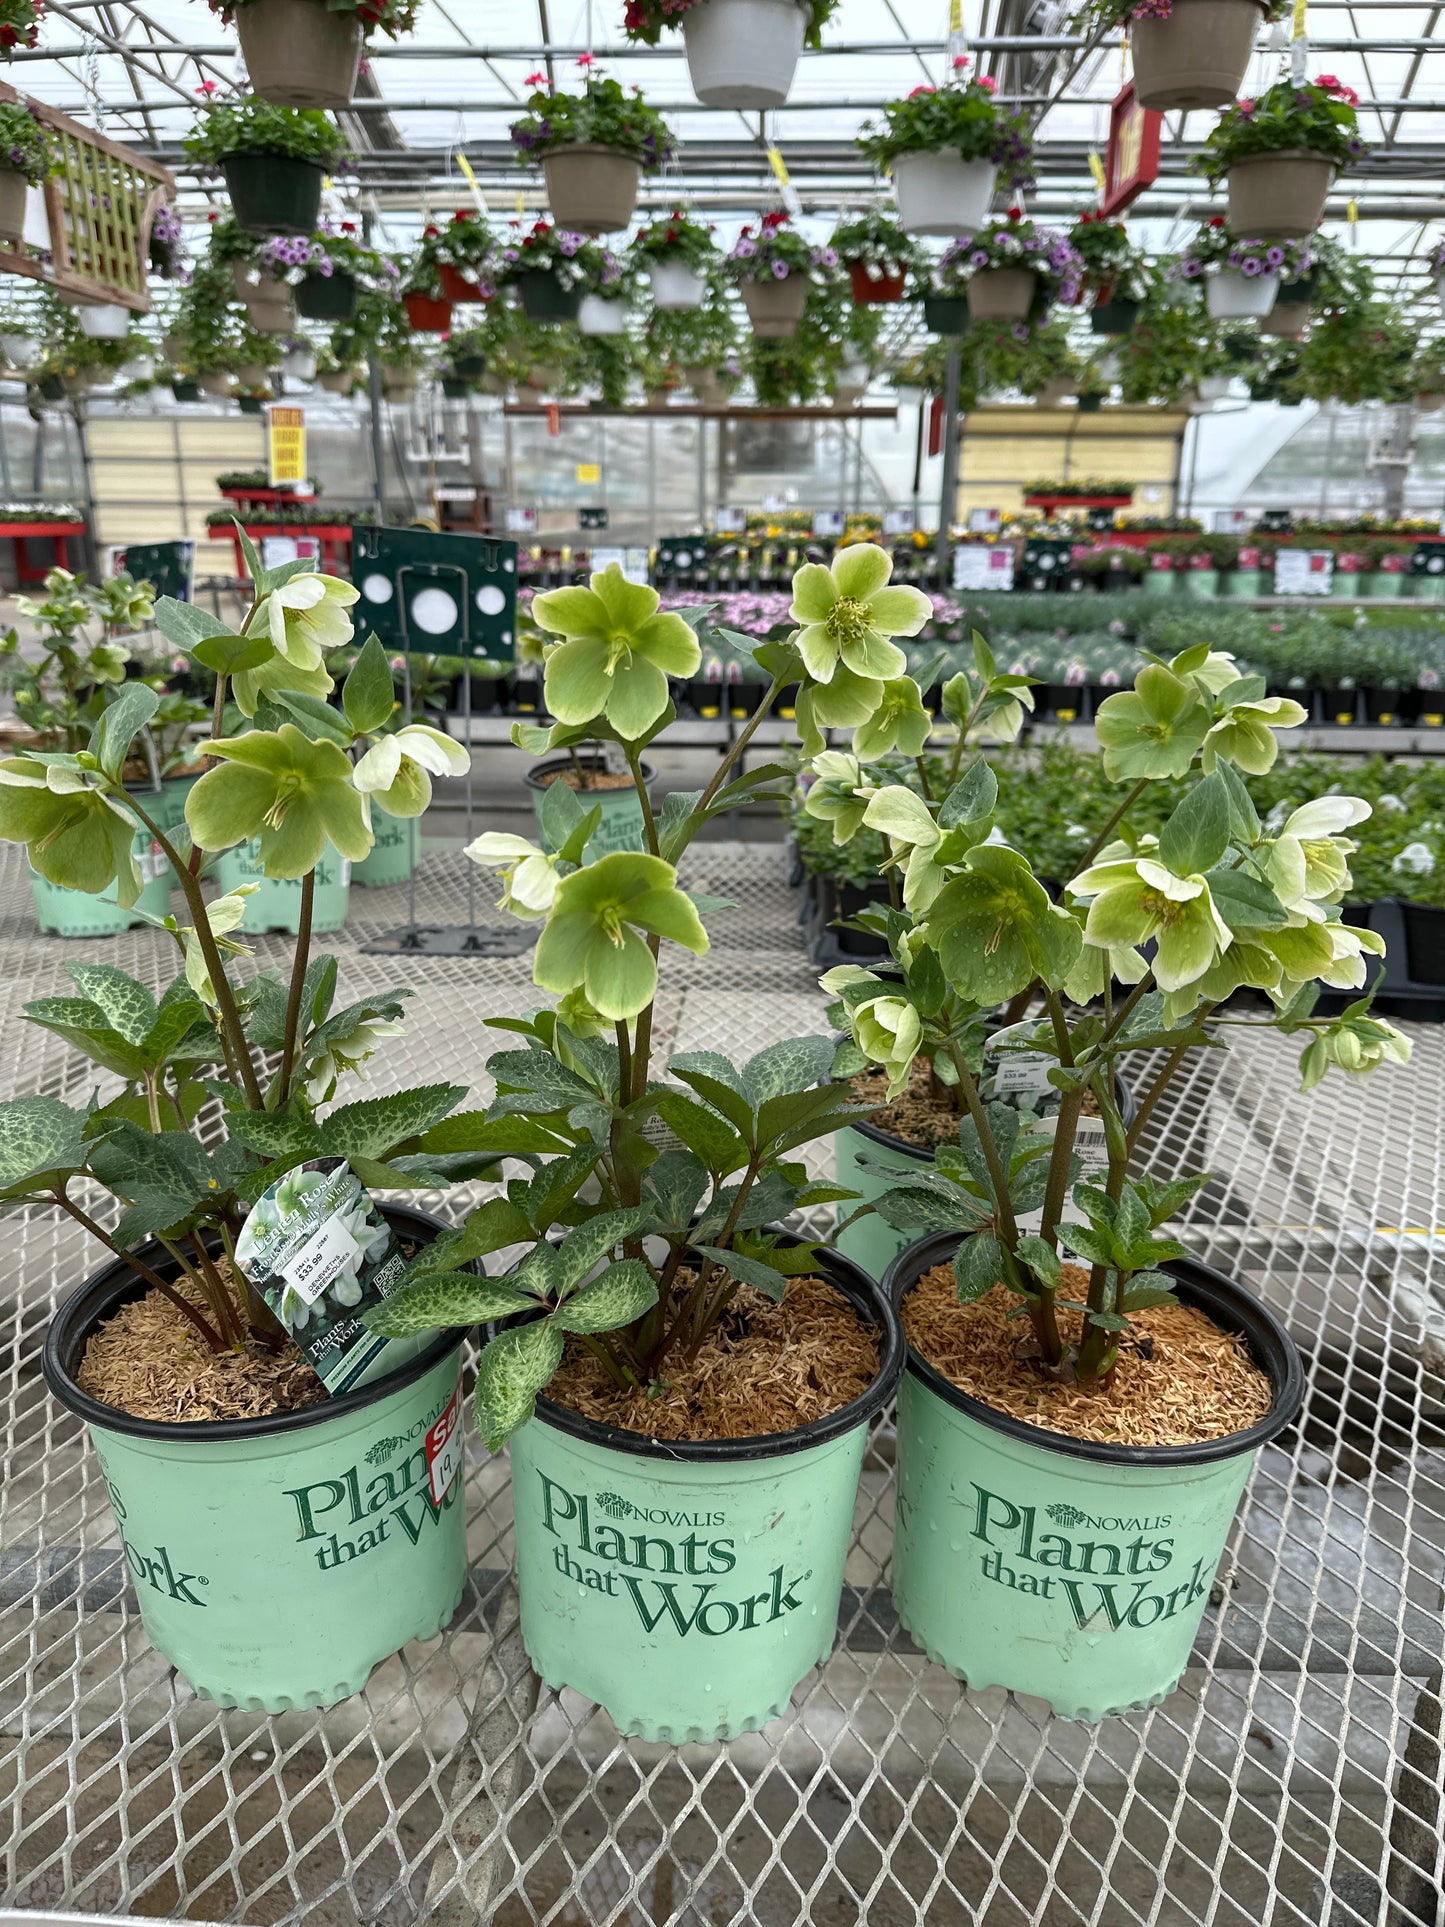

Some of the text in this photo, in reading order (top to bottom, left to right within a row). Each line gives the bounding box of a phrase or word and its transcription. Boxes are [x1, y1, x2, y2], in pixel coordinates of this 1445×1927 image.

[249, 1207, 302, 1255] Lenten
[297, 1174, 334, 1209] Rose
[295, 1200, 326, 1232] Molly's
[324, 1177, 351, 1201] White
[312, 1251, 350, 1296] GREENHOUSES
[308, 1319, 345, 1357] Plants
[330, 1318, 361, 1348] Work
[432, 1382, 463, 1452] Sal
[282, 1446, 431, 1542] Plan
[633, 1508, 725, 1527] NOVALIS
[314, 1518, 392, 1570] that
[536, 1468, 736, 1575] Plants
[969, 1481, 1175, 1576] Plants
[1085, 1514, 1172, 1531] NOVALIS
[552, 1544, 619, 1597] that
[980, 1551, 1056, 1600] that
